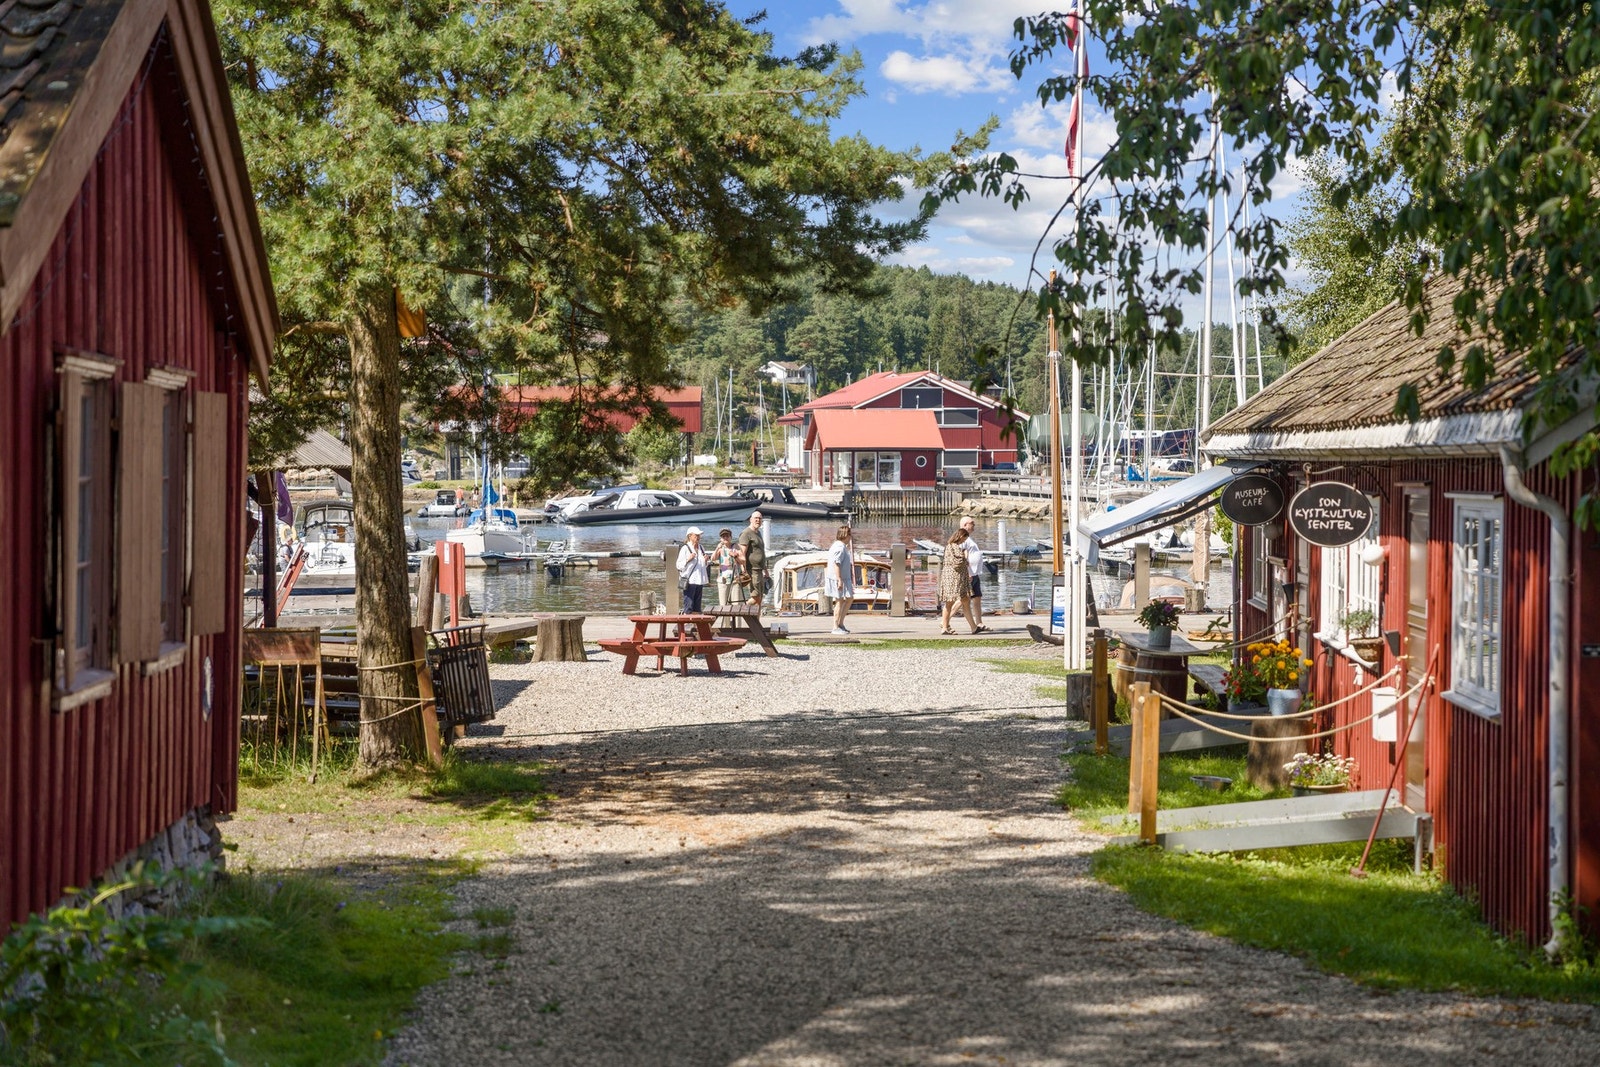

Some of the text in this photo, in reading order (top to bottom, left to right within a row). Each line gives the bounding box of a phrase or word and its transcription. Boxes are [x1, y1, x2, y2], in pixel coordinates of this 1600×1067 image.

[1235, 487, 1269, 499] MUSEUMS-
[1319, 497, 1341, 507] SON
[1295, 508, 1367, 520] KYSTKULTUR-
[1308, 519, 1354, 530] SENTER
